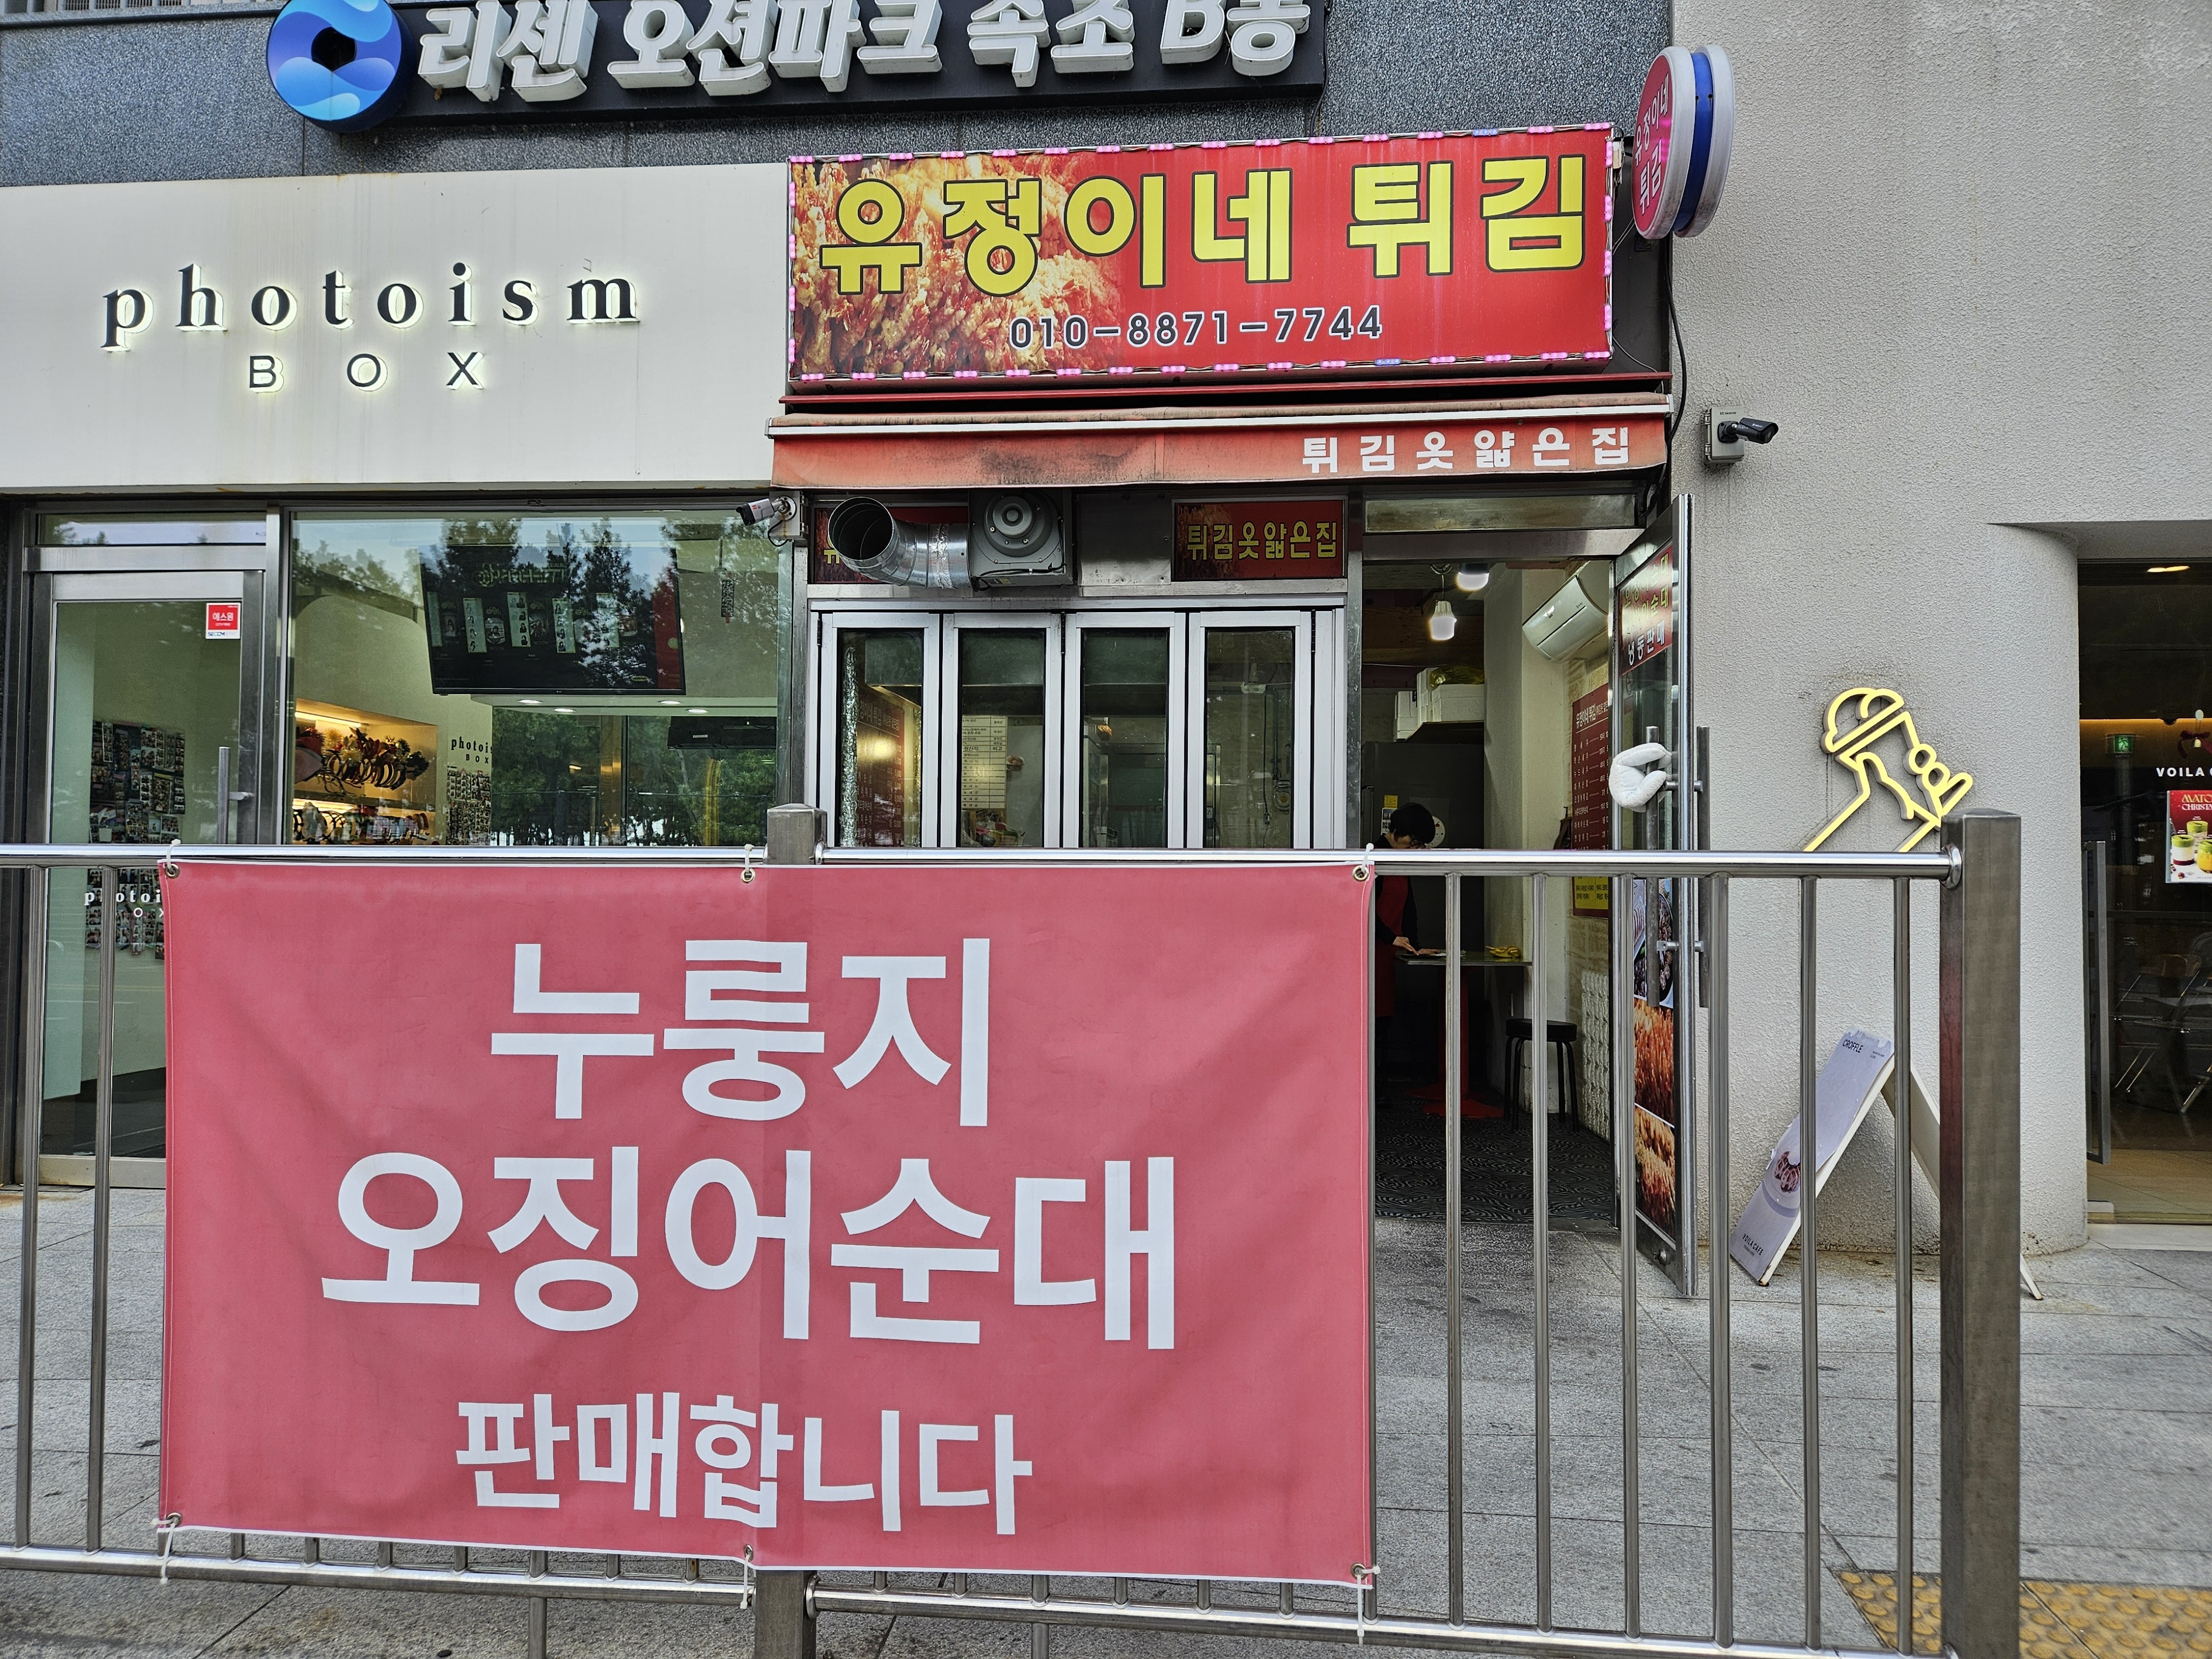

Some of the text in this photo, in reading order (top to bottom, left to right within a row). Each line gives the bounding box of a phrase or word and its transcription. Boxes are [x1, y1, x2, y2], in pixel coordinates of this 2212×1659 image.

[418, 0, 599, 102] 리센
[607, 0, 942, 96] 오션파크
[1635, 73, 1670, 167] 유정이네
[1639, 139, 1662, 216] 튀김
[820, 154, 1586, 297] 유정이네 튀김
[101, 263, 637, 348] photoism
[1009, 304, 1383, 349] 010-8871-7744
[249, 353, 480, 390] BOX
[1628, 620, 1665, 666] 냉동판매
[466, 754, 489, 764] BOX
[2156, 767, 2205, 776] VOILA
[2182, 794, 2212, 803] MATC
[84, 889, 161, 906] potoi
[491, 938, 990, 1126] 누룽지
[1843, 1039, 1864, 1053] CROFFLE
[321, 1146, 1175, 1350] 오징어순대
[1743, 1233, 1754, 1247] VOILA
[1752, 1243, 1764, 1255] CAFE
[456, 1392, 1033, 1536] 판매합니다
